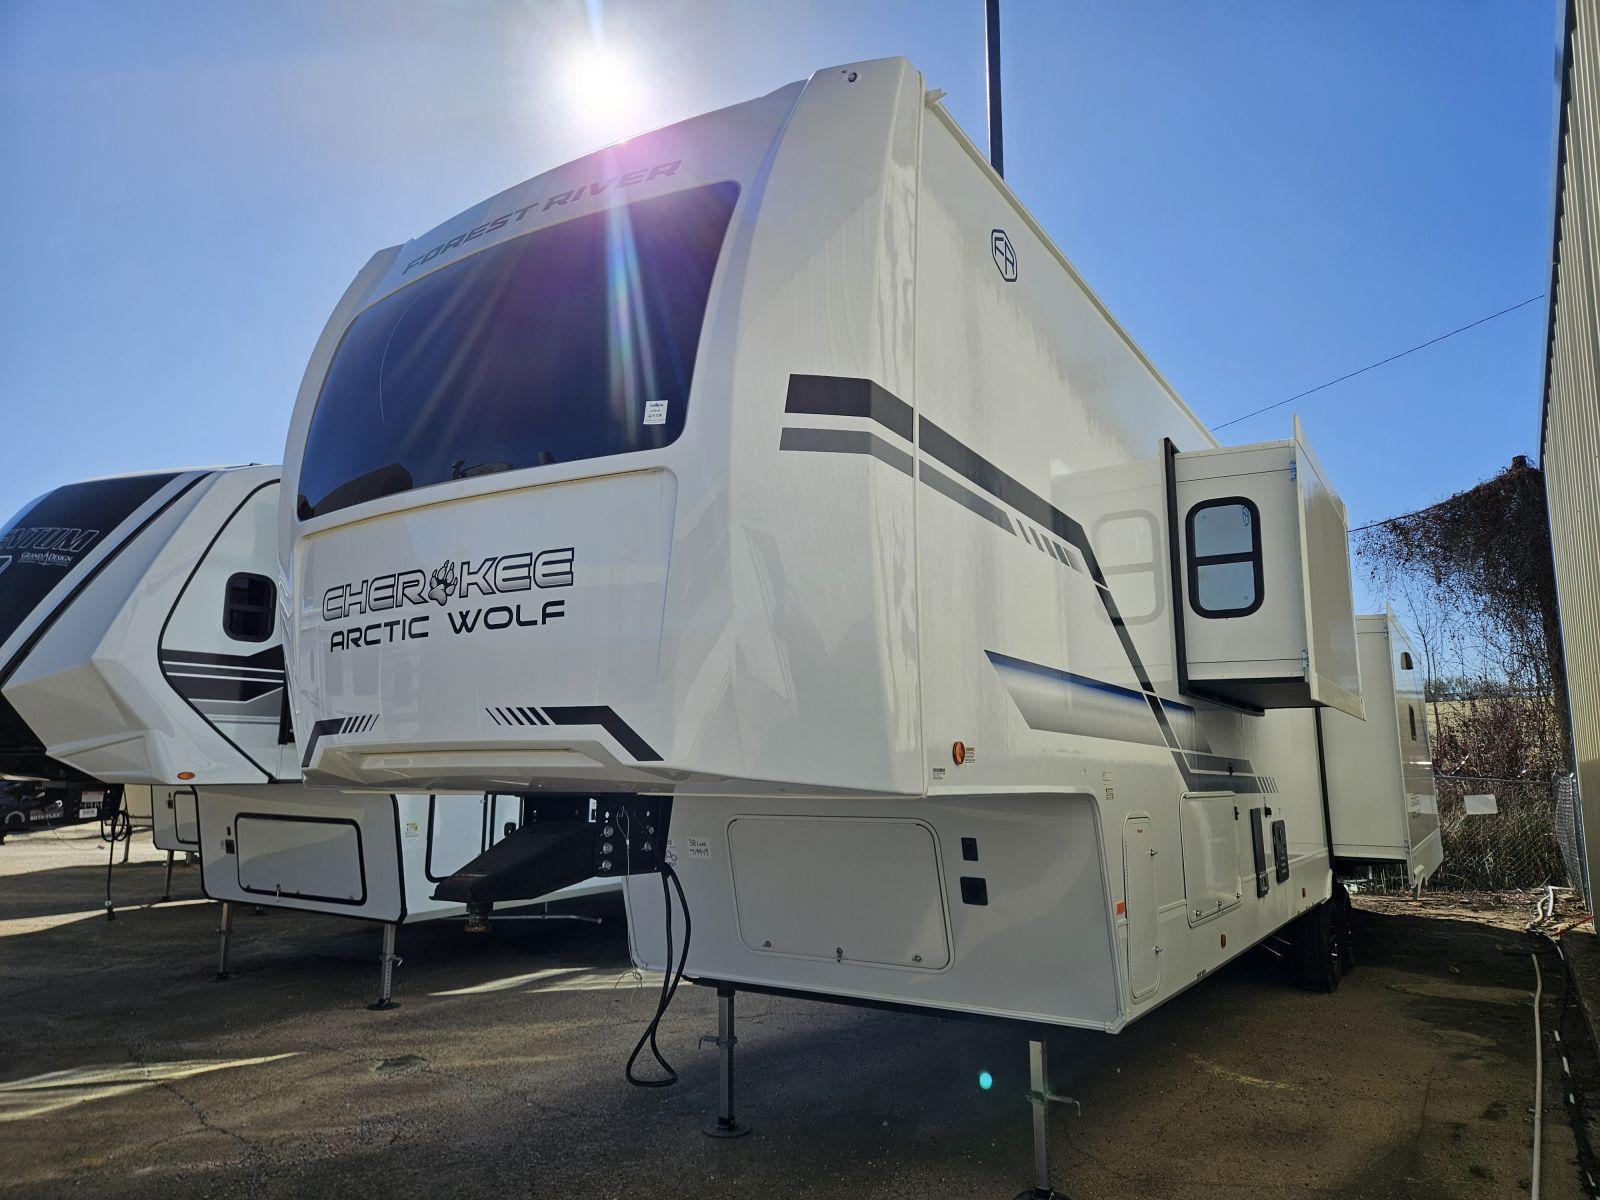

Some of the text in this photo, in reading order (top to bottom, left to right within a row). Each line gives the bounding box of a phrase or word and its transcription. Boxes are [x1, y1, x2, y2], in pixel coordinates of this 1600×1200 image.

[401, 160, 682, 275] FOREST RIVER
[322, 547, 575, 622] CHEROKEE
[330, 599, 566, 652] ARCTIC WOLF
